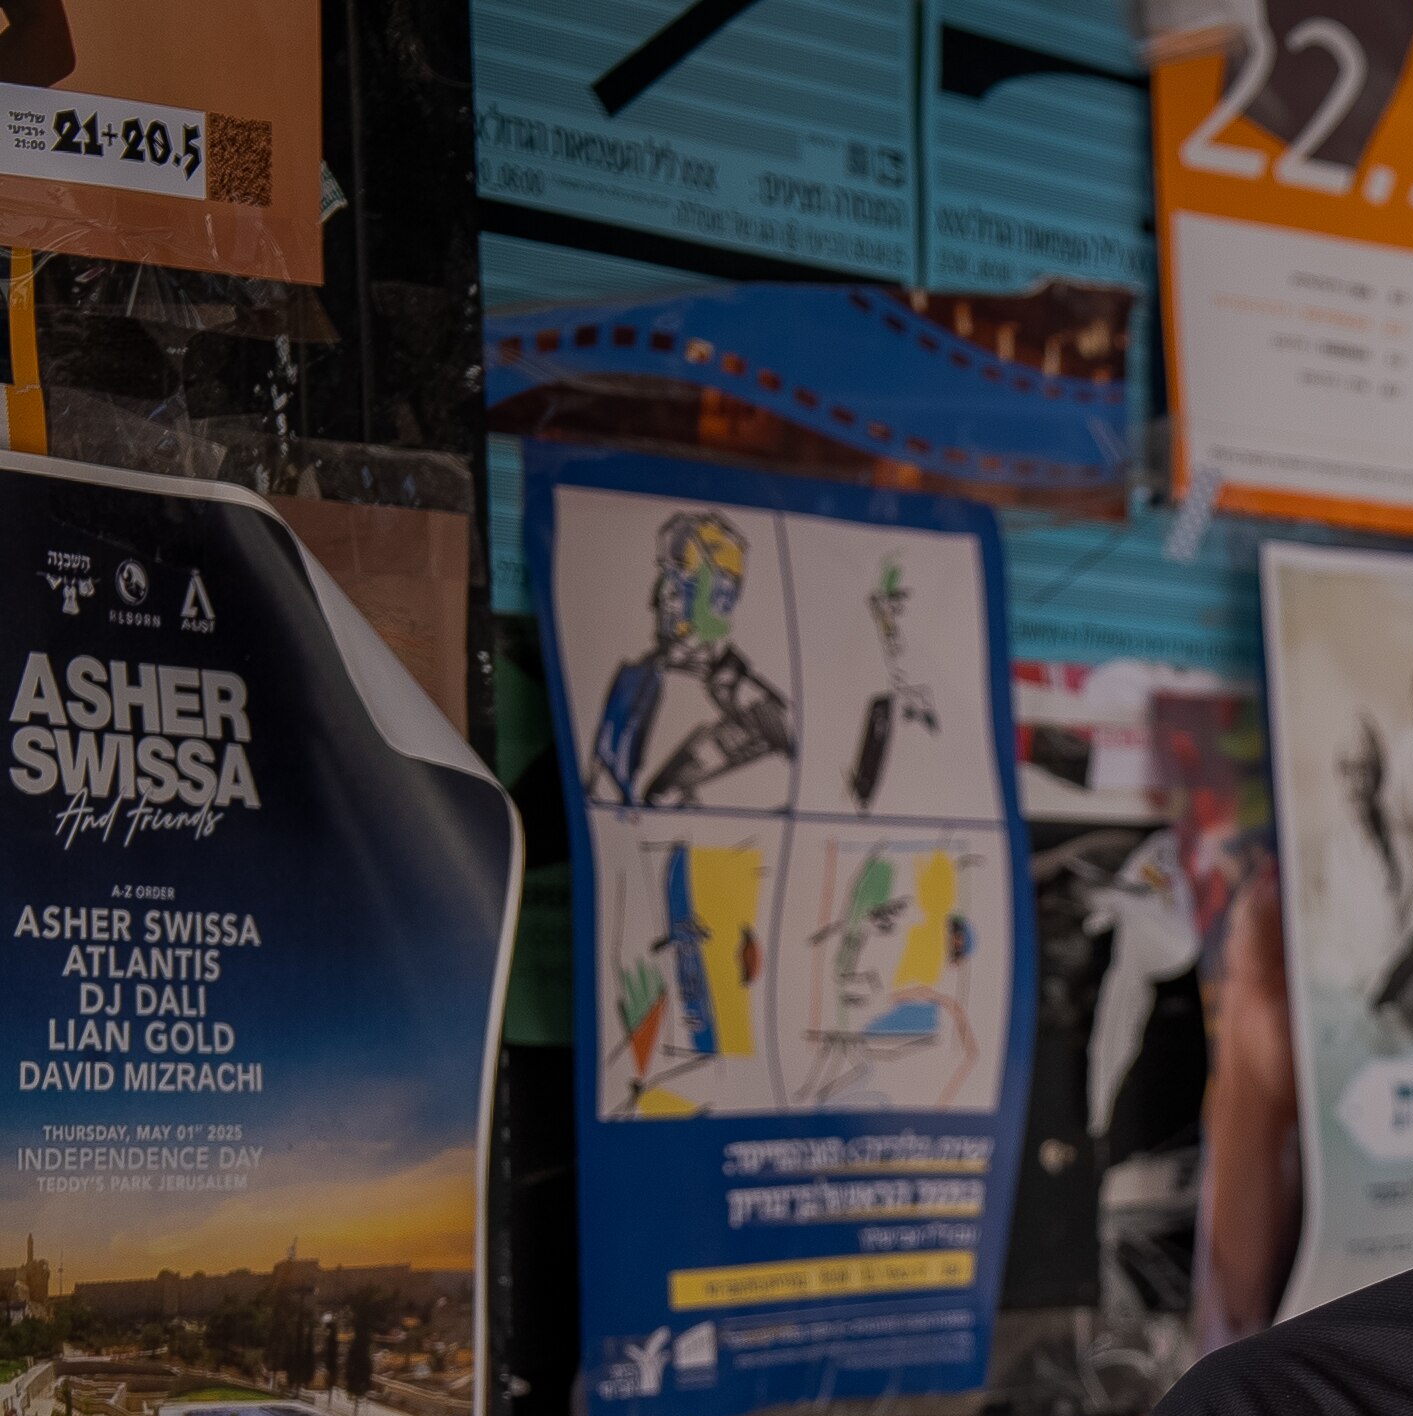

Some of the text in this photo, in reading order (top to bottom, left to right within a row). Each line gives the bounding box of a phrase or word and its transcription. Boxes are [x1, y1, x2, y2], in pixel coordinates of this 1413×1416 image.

[8, 110, 46, 124] שלישי
[14, 137, 46, 151] 21:00
[10, 651, 251, 742] ASHER
[10, 725, 261, 809] SWISSA
[55, 786, 126, 850] And
[135, 886, 176, 900] ORDER
[14, 904, 262, 947] ASHER SWISSA
[62, 945, 220, 982] ATLANTIS
[79, 982, 206, 1017] DJ DALI
[48, 1018, 235, 1054] LIAN GOLD
[19, 1061, 263, 1092] DAVID MIZRACHI
[43, 1125, 131, 1144] THURSDAY,
[137, 1125, 171, 1141] MAY
[208, 1124, 243, 1142] 2025
[17, 1146, 263, 1171] INDEPENDENCE DAY
[37, 1174, 248, 1193] TEDDY'S PARK JERUSALEM
